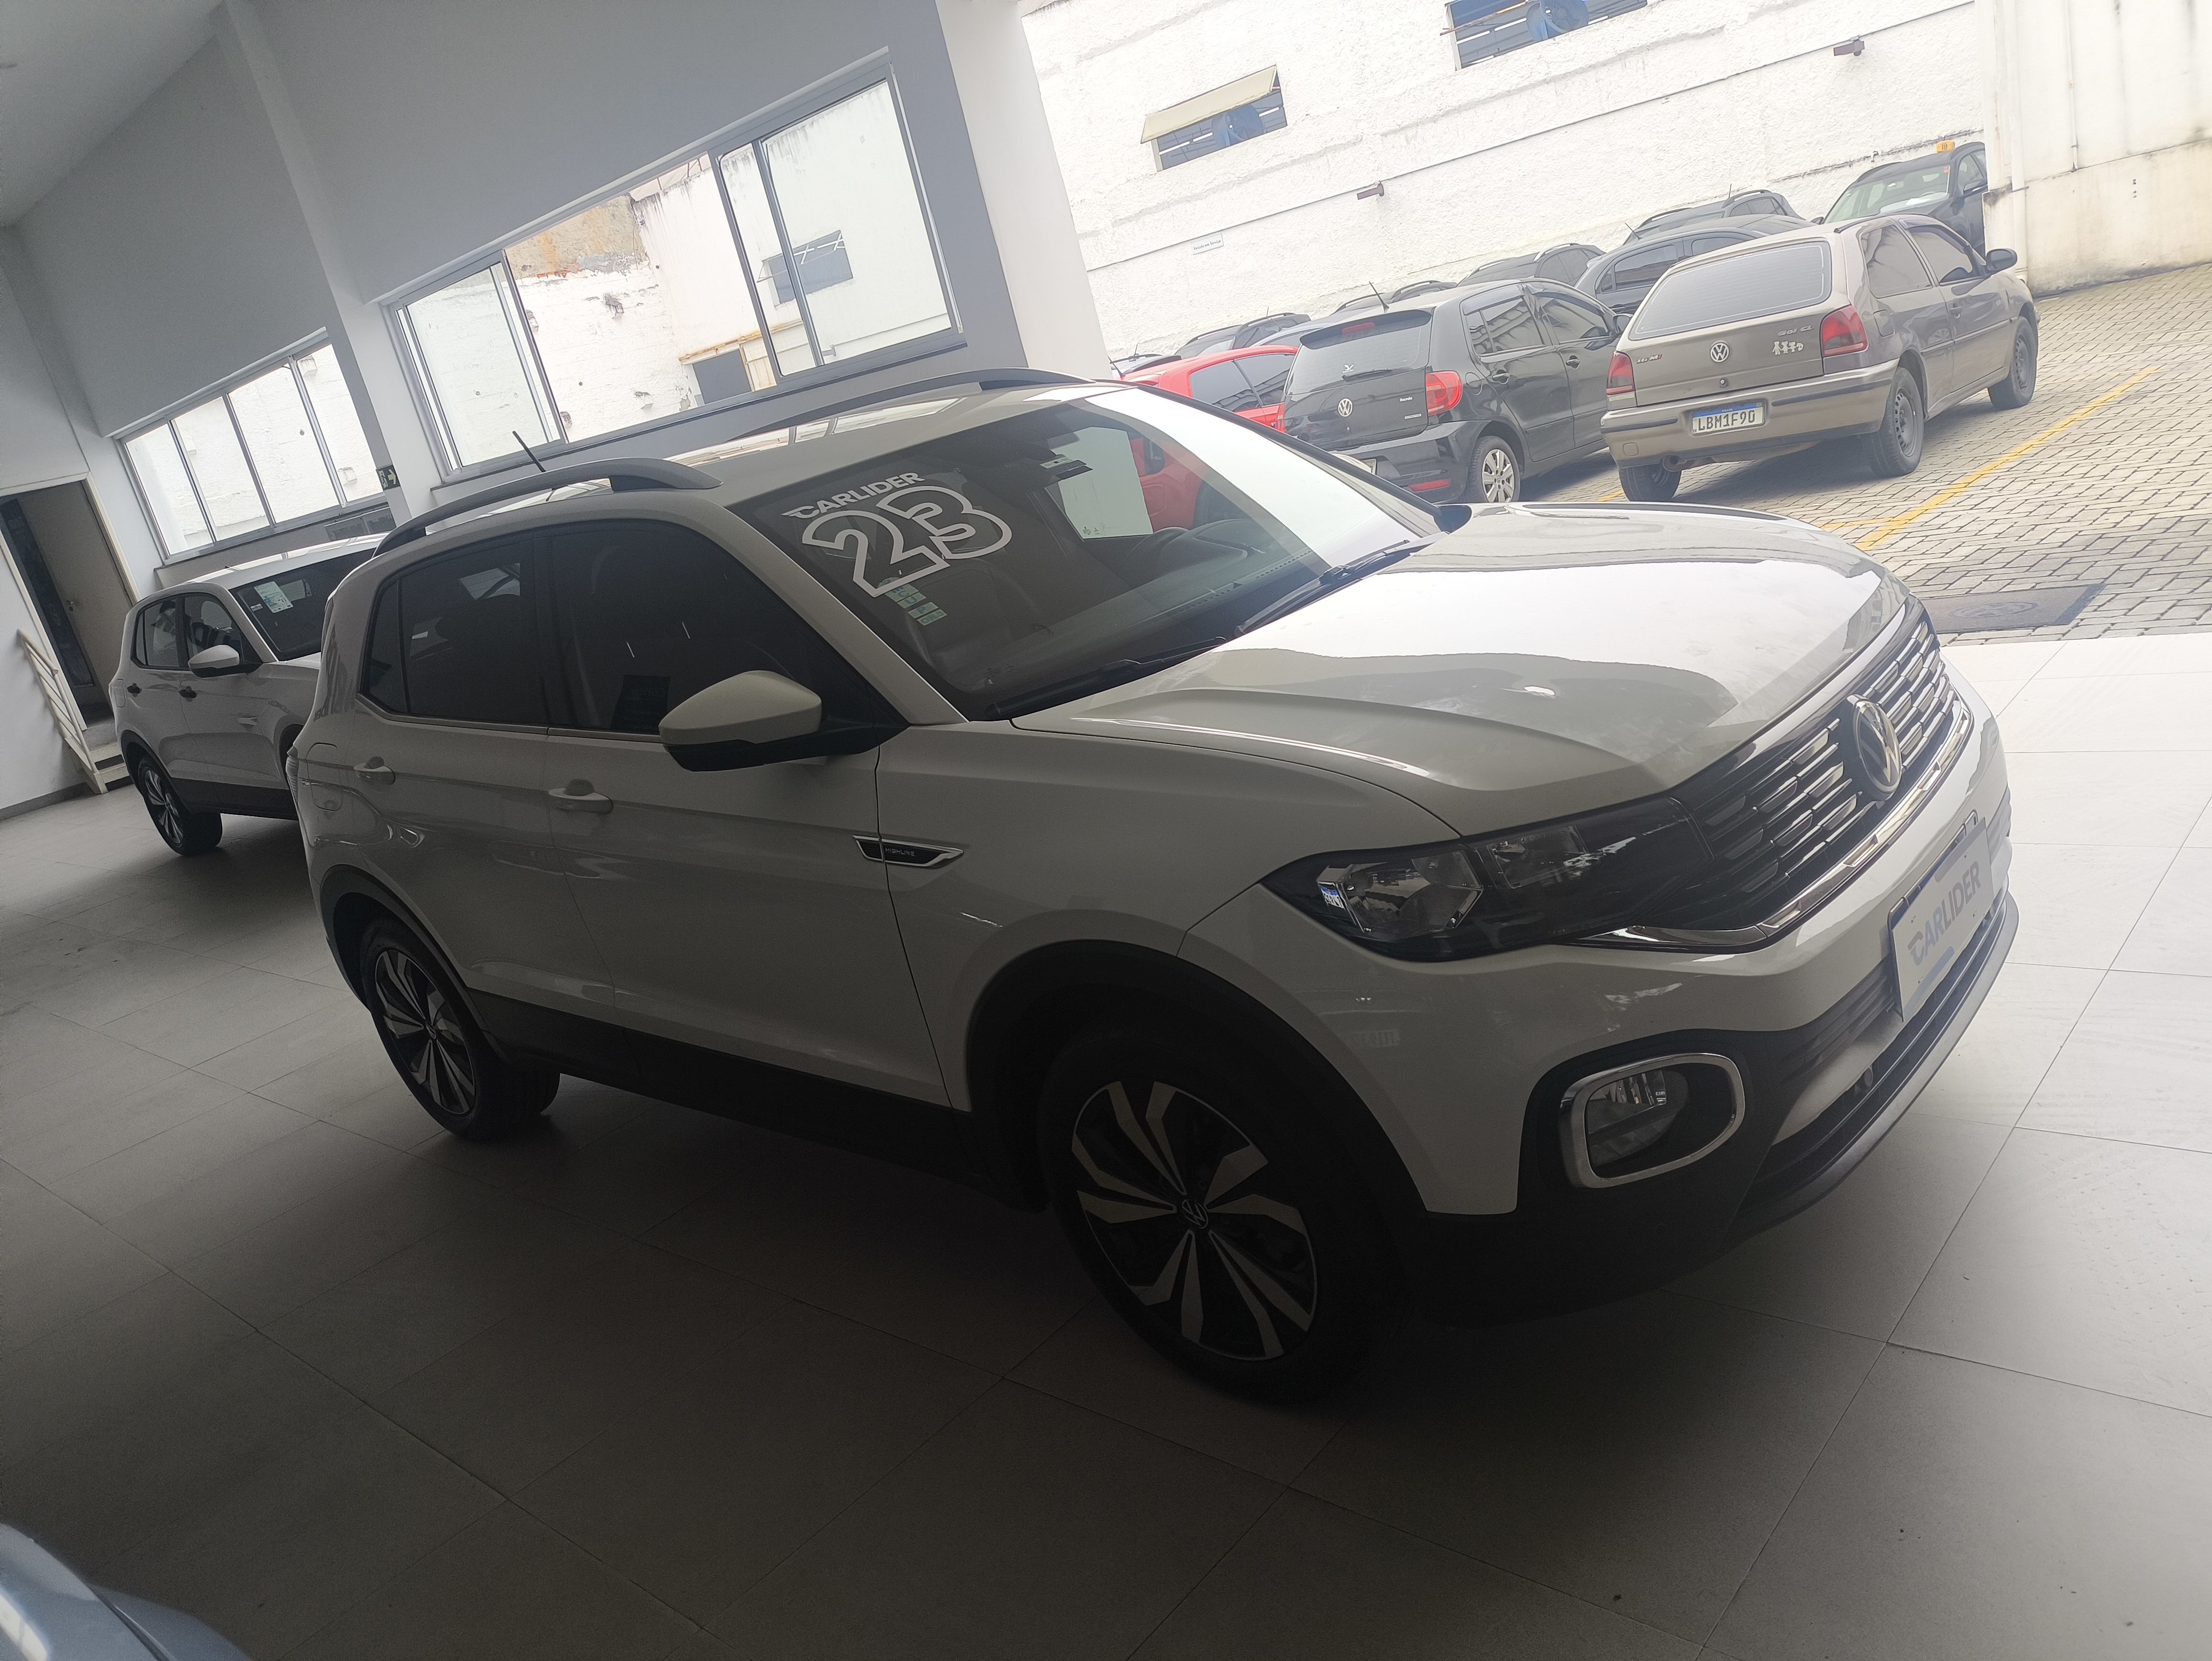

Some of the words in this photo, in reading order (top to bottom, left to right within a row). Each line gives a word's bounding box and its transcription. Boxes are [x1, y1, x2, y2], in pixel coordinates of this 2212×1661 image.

[781, 472, 926, 518] CARLIDER
[802, 486, 1013, 598] 23
[1908, 861, 1981, 966] CARLIDER
